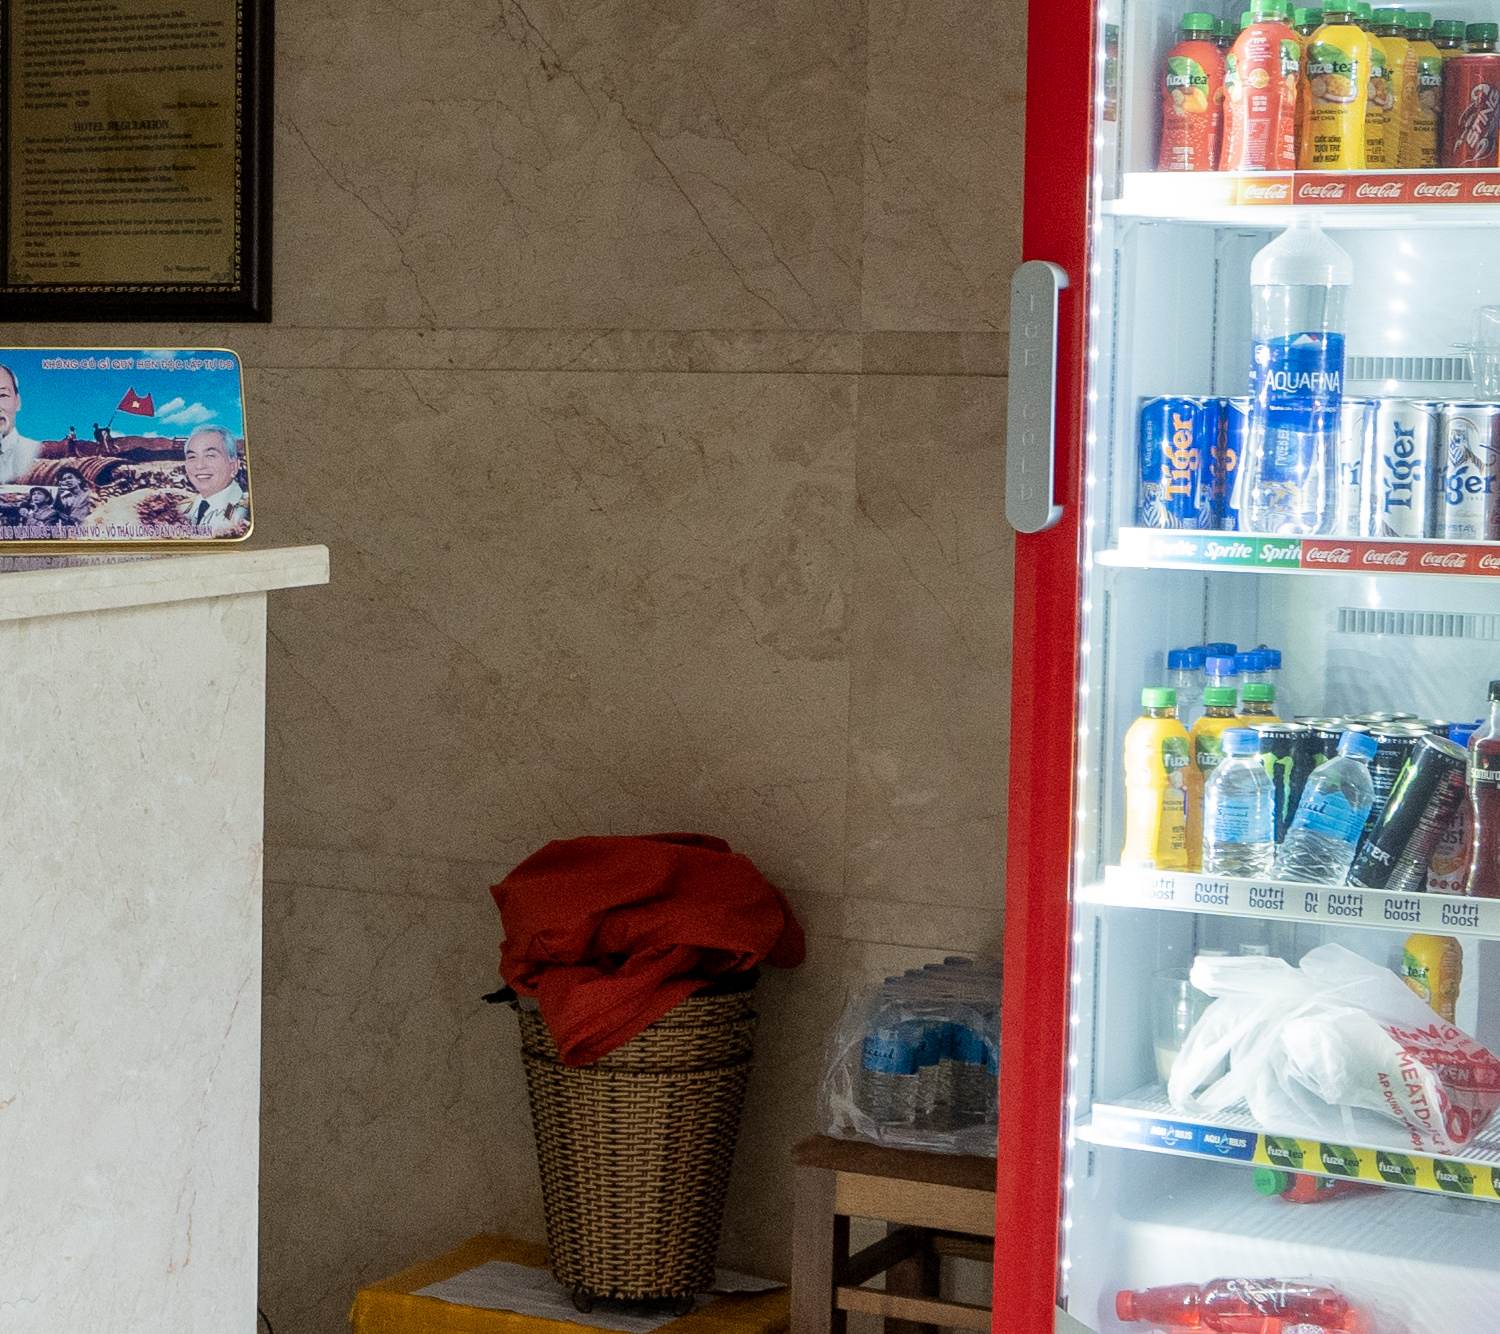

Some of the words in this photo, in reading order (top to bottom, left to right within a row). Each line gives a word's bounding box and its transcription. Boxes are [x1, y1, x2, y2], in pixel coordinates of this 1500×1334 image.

[1165, 72, 1211, 87] fuzetea
[73, 121, 104, 133] HOTEL
[107, 119, 169, 132] REGULATION
[1243, 183, 1290, 200] Coca-Cola
[1298, 182, 1345, 199] Coca-Cola
[1356, 182, 1403, 199] Coca-Cola
[1413, 182, 1459, 198] Coca-Cola
[42, 357, 79, 370] KHÔNG
[80, 356, 96, 370] CÓ
[97, 357, 110, 370] GÌ
[111, 357, 134, 371] QUÝ
[160, 359, 182, 372] ĐỘC
[1265, 369, 1341, 394] AQUAFINA
[1164, 412, 1193, 500] Tiger
[1384, 420, 1417, 514] Tiger
[1204, 542, 1253, 561] Sprite
[1306, 547, 1353, 565] Coca-Cola
[1362, 549, 1409, 567] Coca-Cola
[1420, 551, 1467, 569] Coca-Cola
[1194, 882, 1230, 895] nutri
[1249, 886, 1285, 899] nutri
[1194, 891, 1230, 906] boost
[1248, 896, 1285, 911] boost
[1328, 893, 1364, 906] nutri
[1384, 898, 1421, 911] nutri
[1327, 902, 1364, 918] boost
[1383, 907, 1421, 922] boost
[1442, 903, 1479, 916] nutri
[1441, 913, 1479, 928] boost
[1203, 1132, 1247, 1149] AQUARIUS
[1266, 1146, 1304, 1161] fuzetea
[1322, 1153, 1361, 1169] fuzetea
[1378, 1160, 1418, 1176] fuzetea
[1435, 1169, 1475, 1185] fuzetea
